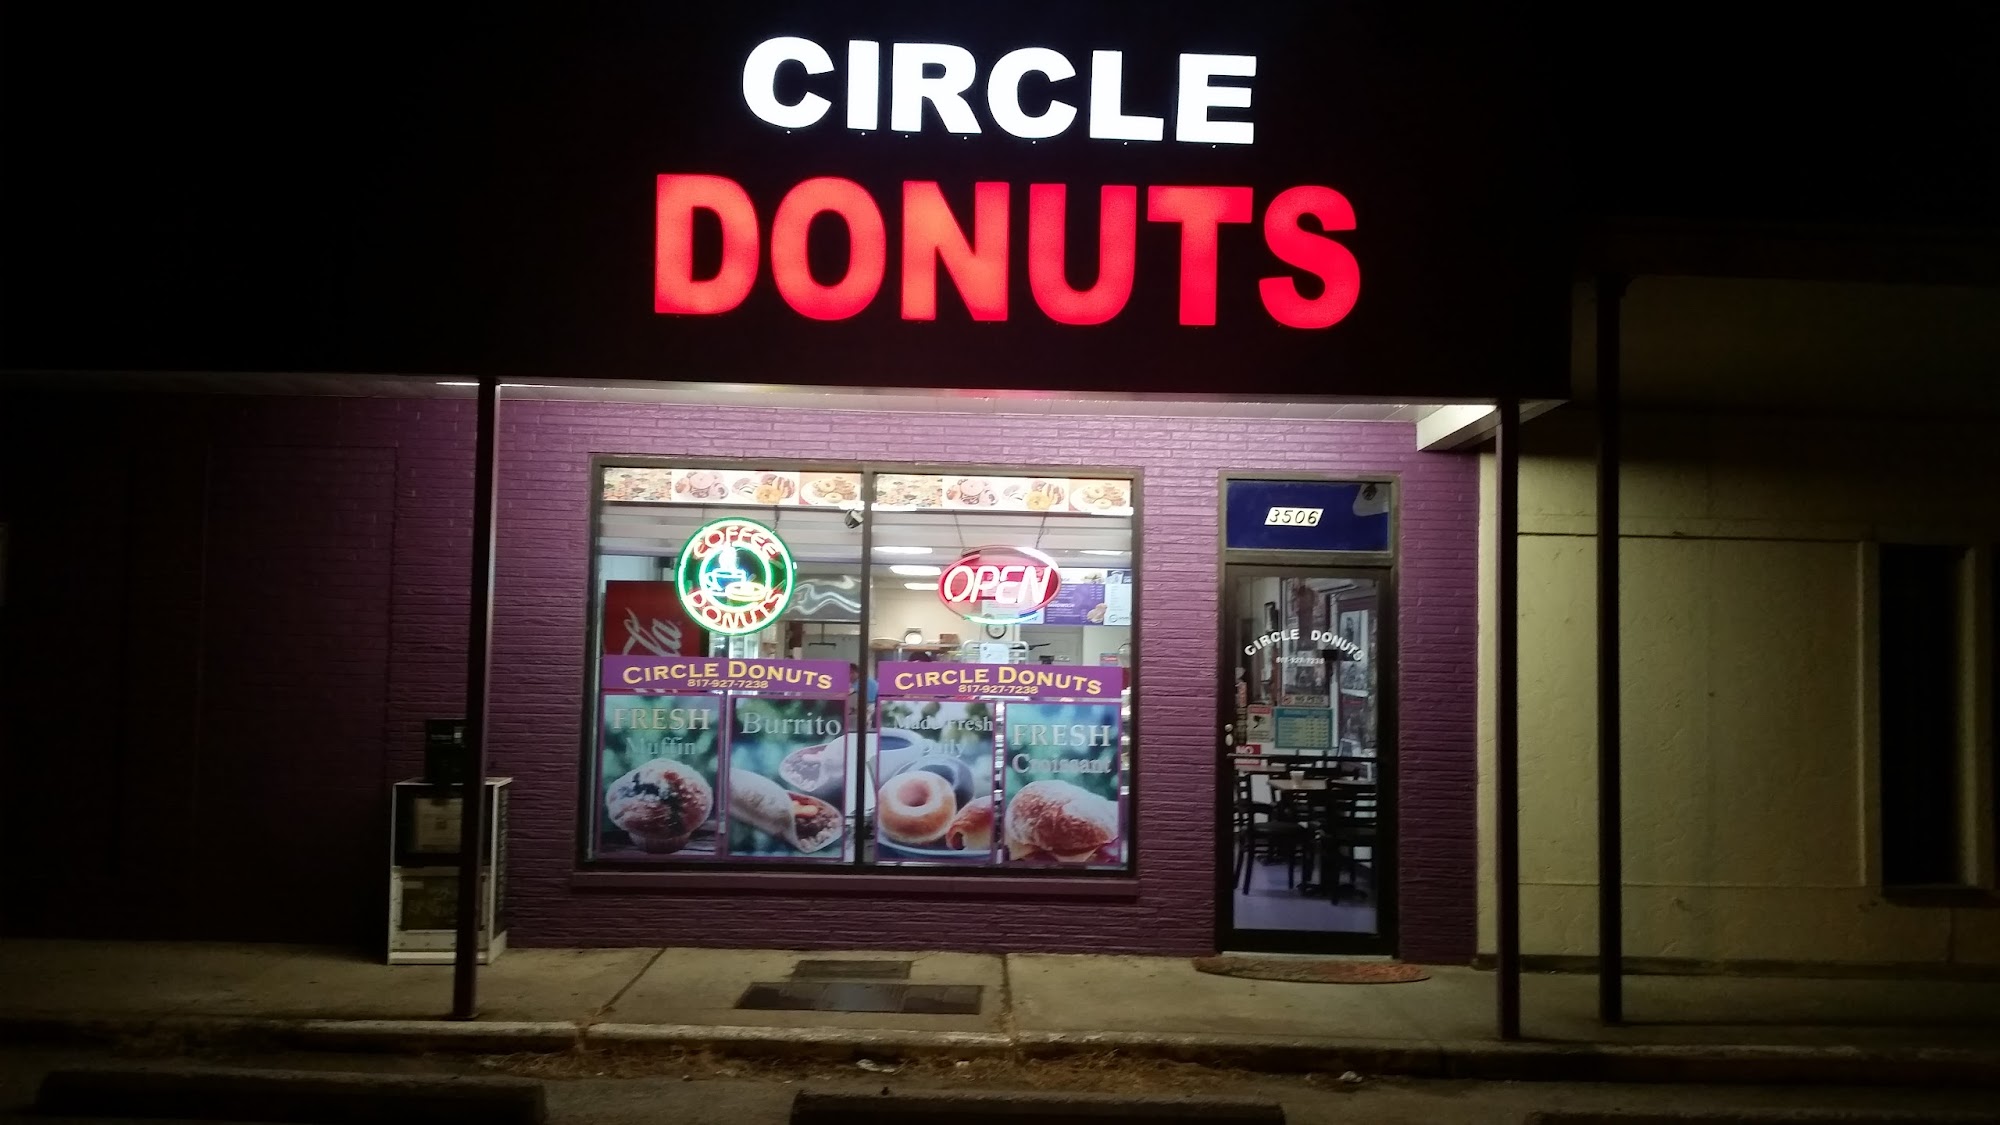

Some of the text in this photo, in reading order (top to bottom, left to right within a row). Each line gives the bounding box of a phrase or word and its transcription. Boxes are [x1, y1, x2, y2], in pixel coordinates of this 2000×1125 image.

[742, 36, 1257, 144] CIRCLE
[654, 173, 1361, 329] DONUTS
[1269, 508, 1319, 525] 3506
[693, 525, 784, 560] COFFEE
[943, 565, 1051, 604] OPEN
[686, 588, 784, 628] DONUTS
[1244, 628, 1366, 662] CIRCLE DONUTS
[622, 660, 833, 690] CIRCLE DONUTS
[686, 679, 769, 689] 817-927-7238
[894, 665, 1102, 695] CIRCLE DONUTS
[957, 684, 1039, 695] 817-927-7238
[613, 707, 711, 731] FRESH
[741, 711, 842, 736] Burrito
[948, 716, 994, 732] Fresh
[624, 737, 697, 756] Muffin
[1011, 723, 1112, 747] FRESH
[1011, 753, 1112, 774] Croissant
